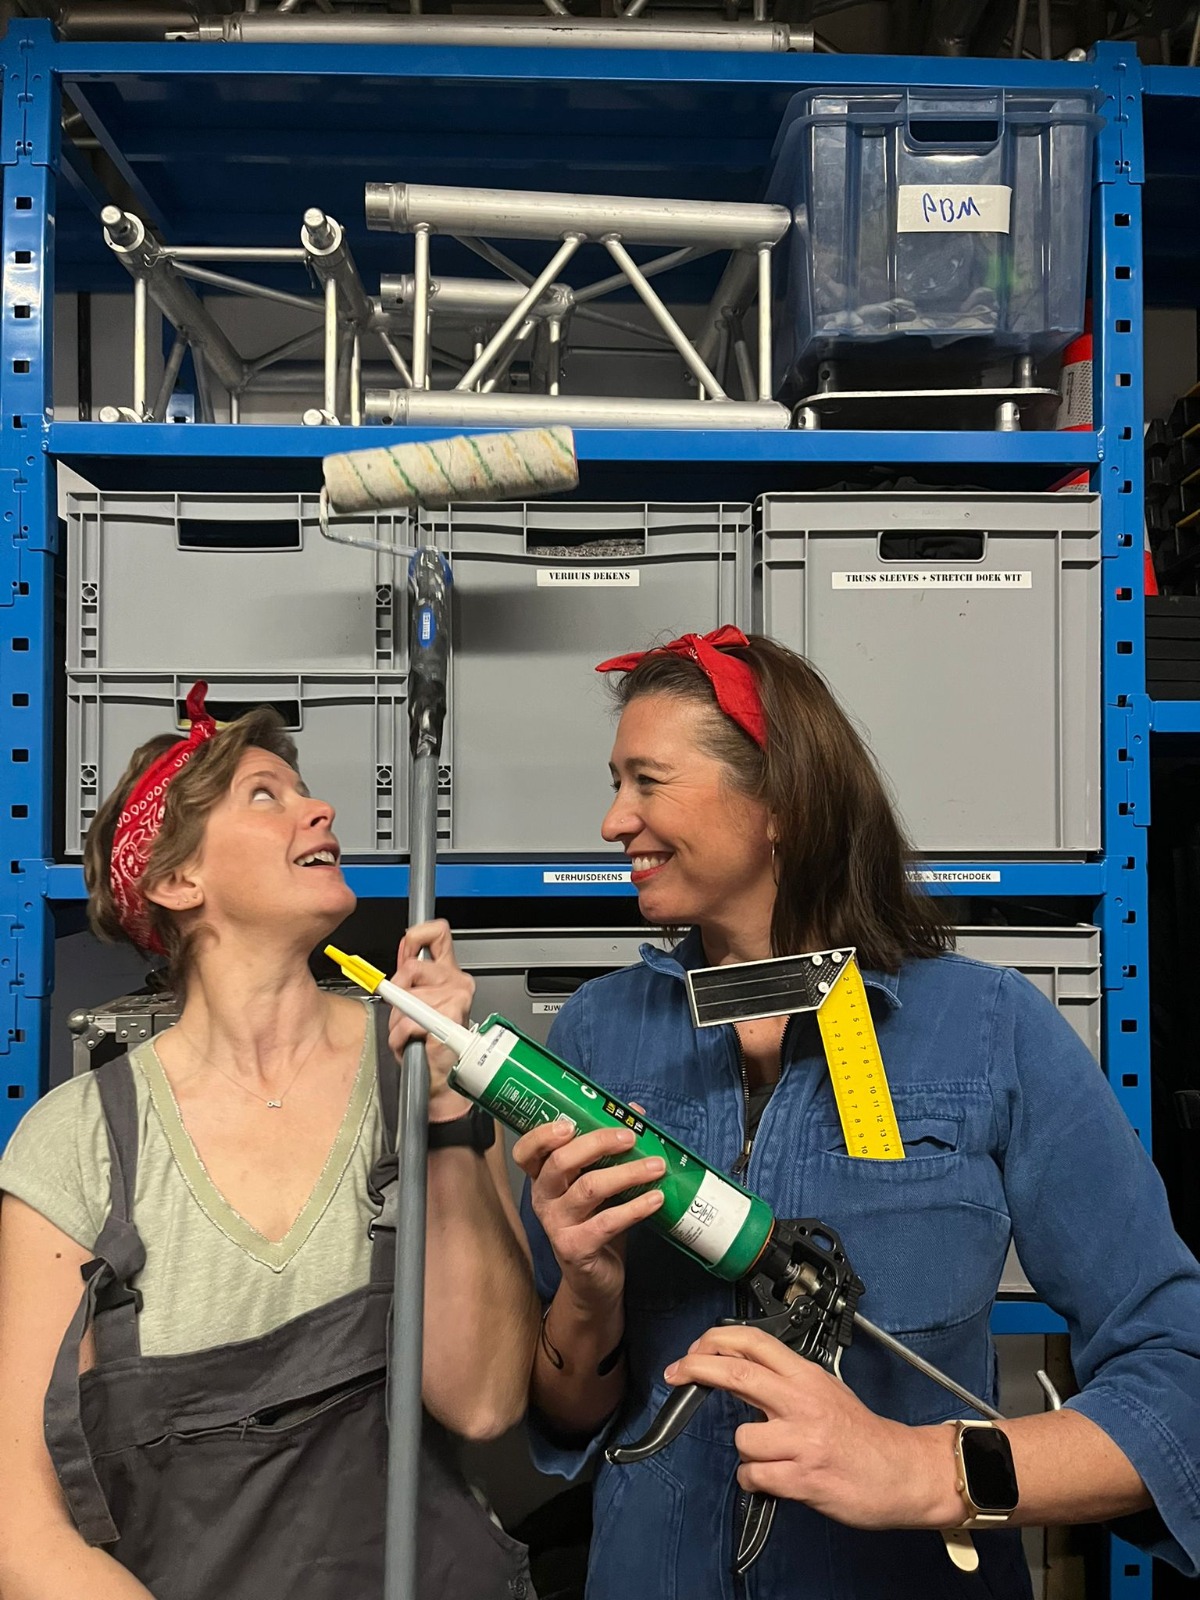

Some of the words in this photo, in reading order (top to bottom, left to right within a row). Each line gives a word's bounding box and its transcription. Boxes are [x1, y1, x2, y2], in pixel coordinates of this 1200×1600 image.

[549, 572, 590, 580] VERHUIS
[593, 572, 630, 580] DEKENS
[845, 574, 876, 582] TRUSS
[879, 574, 919, 582] SLEEVES
[930, 573, 973, 582] STRETCH
[976, 573, 1001, 582] DOEK
[1004, 573, 1022, 582] WIT
[555, 873, 623, 881] VERHUISDEKENS
[933, 873, 991, 881] STRETCHDOEK
[870, 1086, 877, 1094] 10
[873, 1100, 880, 1108] 11
[876, 1114, 883, 1123] 12
[880, 1128, 887, 1137] 13
[861, 1145, 868, 1154] 10
[883, 1143, 890, 1152] 14
